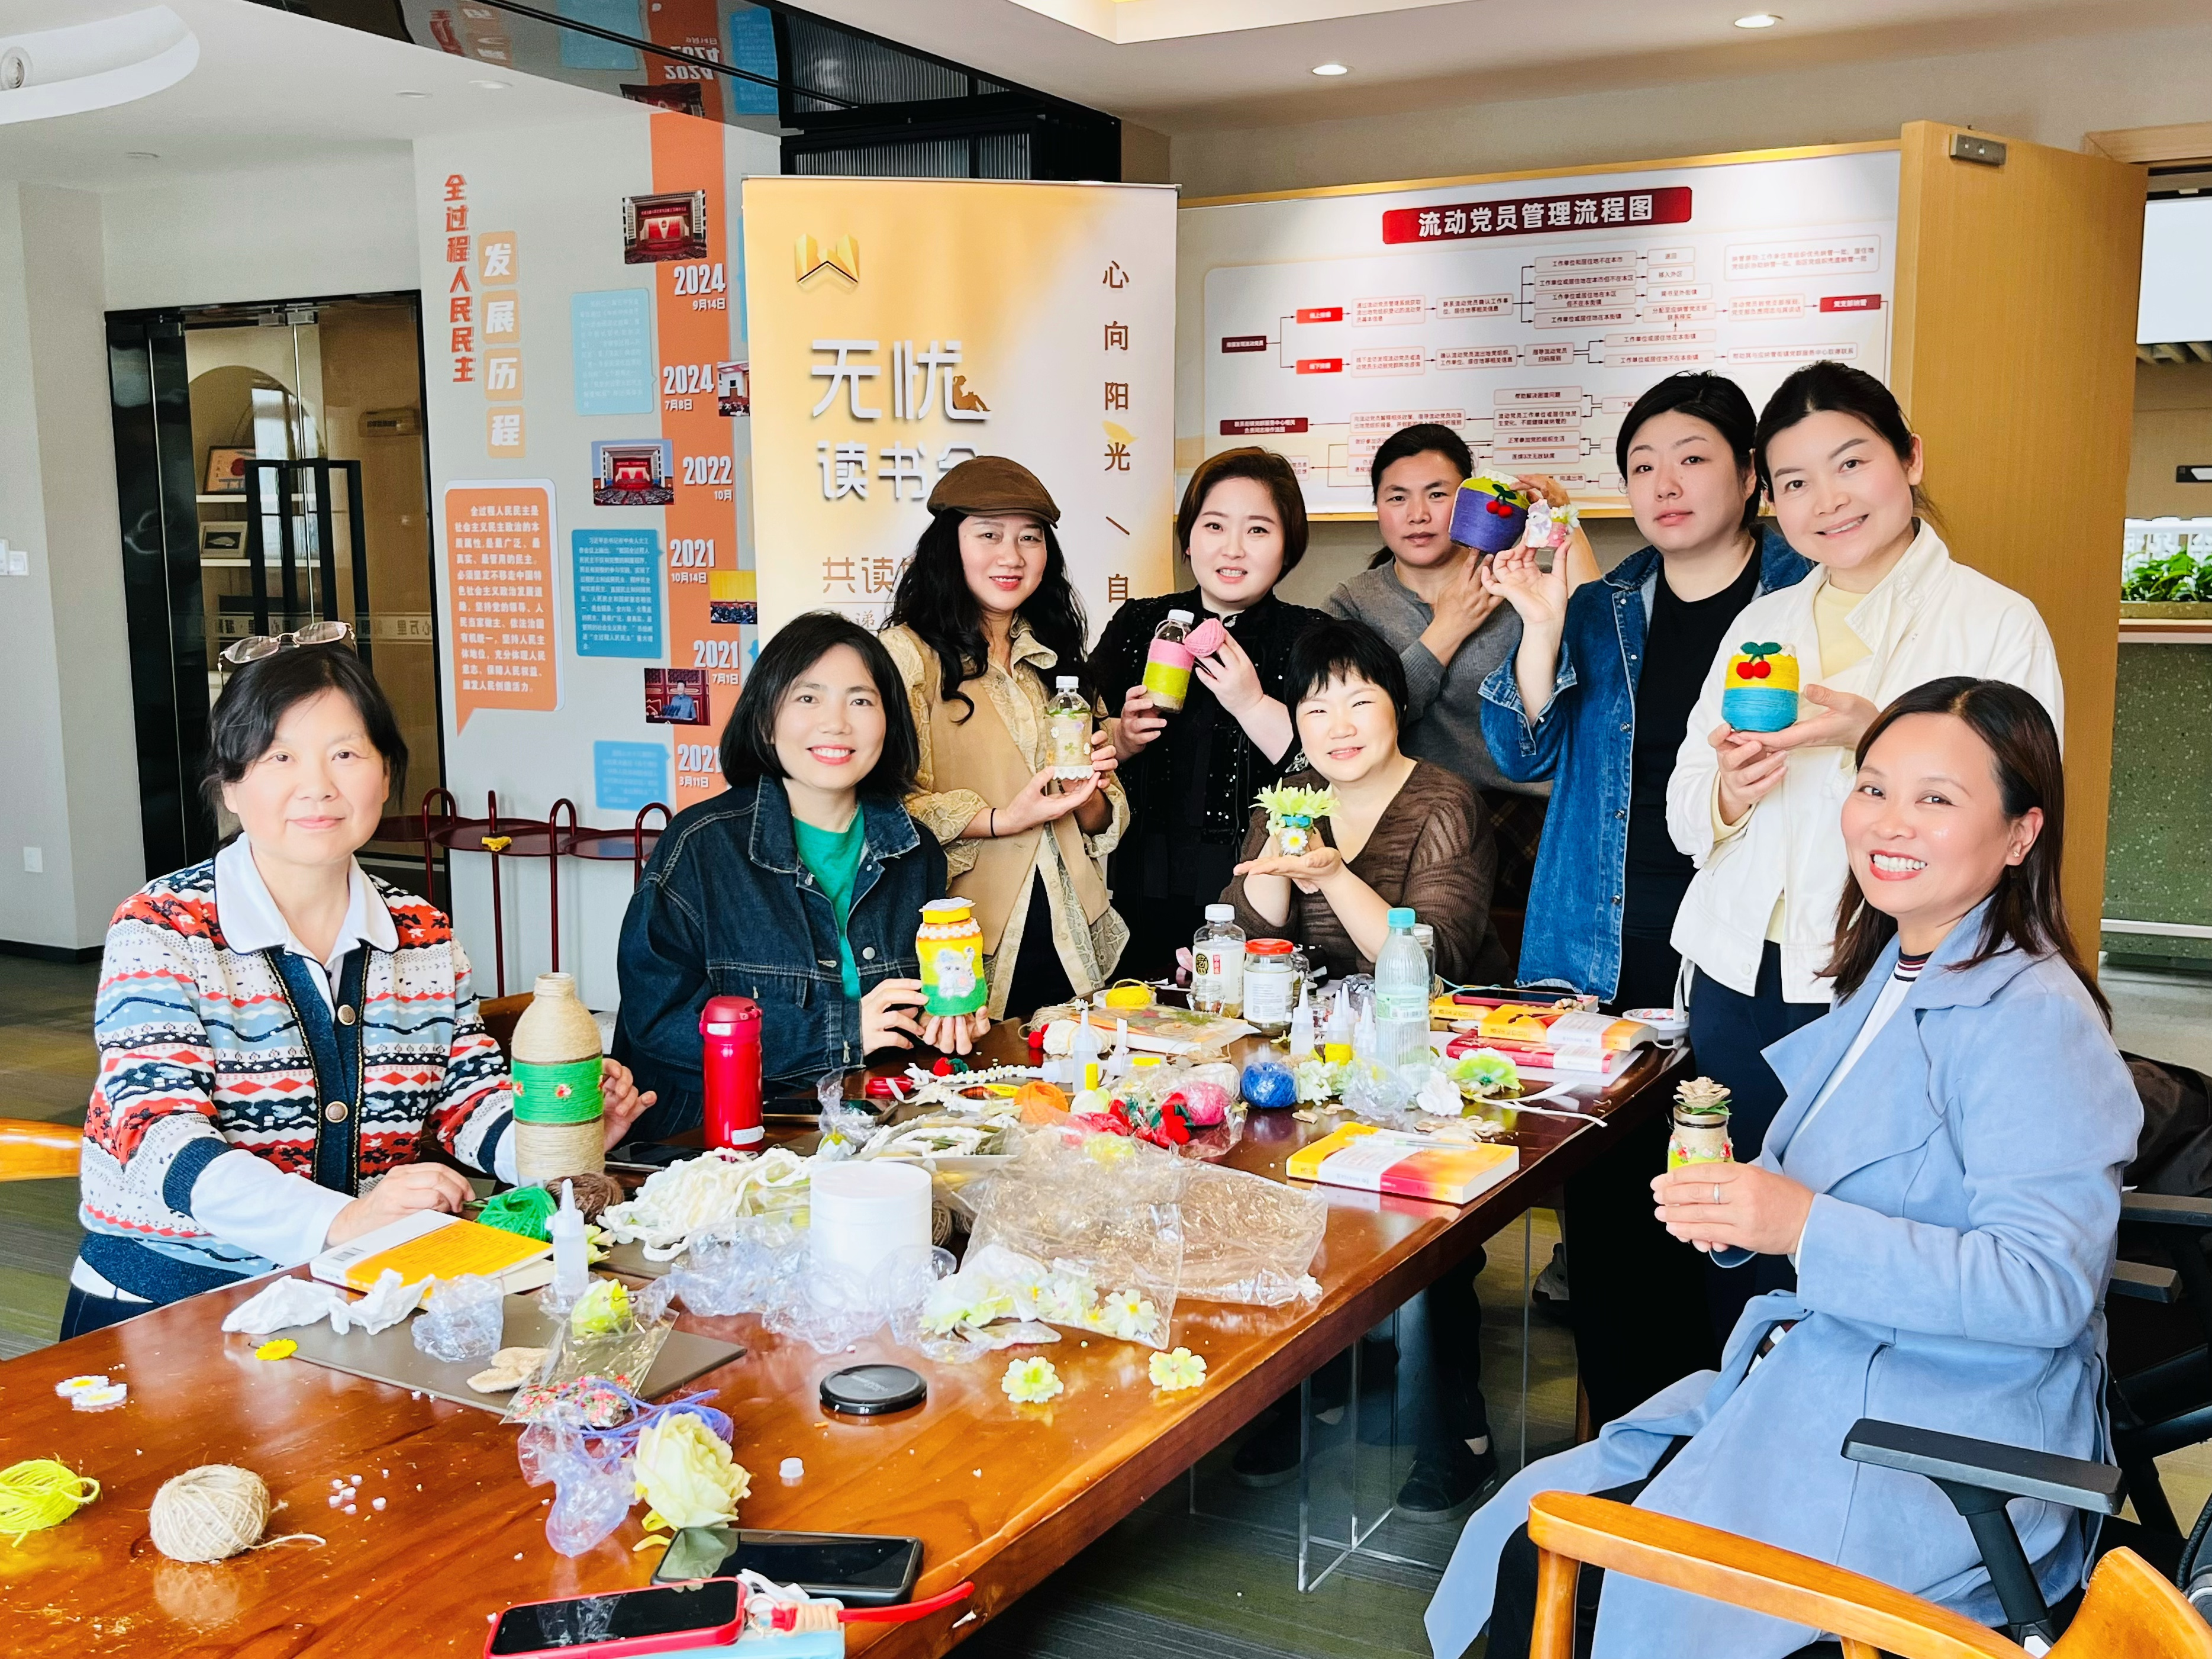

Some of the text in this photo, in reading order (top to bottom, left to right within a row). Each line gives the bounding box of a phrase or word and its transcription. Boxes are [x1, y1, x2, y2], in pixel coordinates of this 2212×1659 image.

[1418, 194, 1653, 237] 流动党员管理流程图
[443, 174, 476, 382] 全过程人民民主
[673, 263, 726, 296] 2024
[692, 298, 726, 311] 9月14日
[483, 243, 520, 447] 发展历程
[663, 363, 715, 395] 2024
[811, 339, 992, 421] 无忧
[1102, 260, 1131, 471] 心向阳光
[682, 455, 733, 485] 2022
[714, 489, 733, 501] 10月
[670, 539, 715, 568] 2021
[670, 571, 707, 584] 10月14日
[694, 640, 739, 669] 2021
[712, 672, 739, 685] 7月1日
[679, 775, 710, 788] 3月11日
